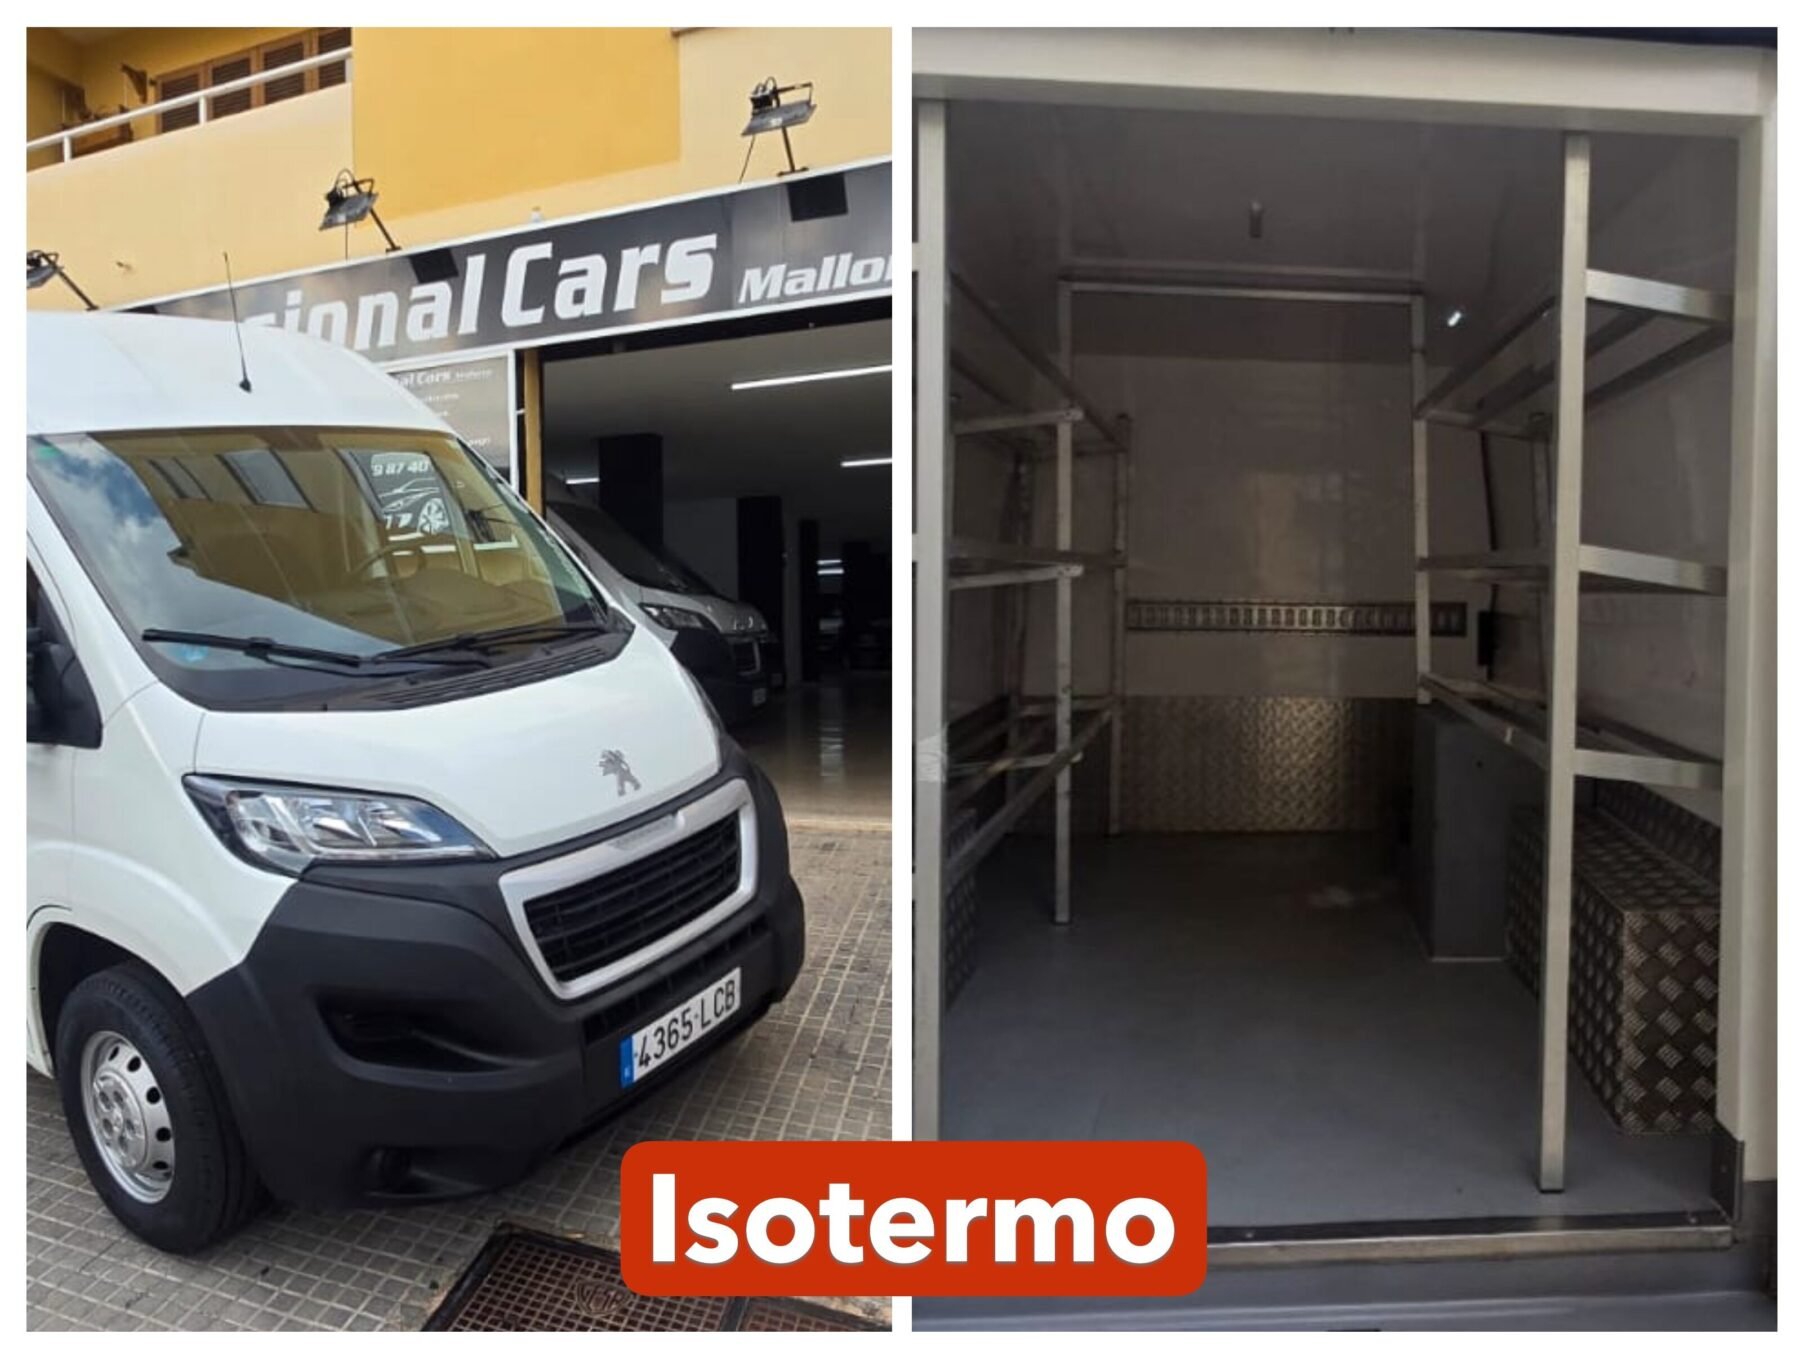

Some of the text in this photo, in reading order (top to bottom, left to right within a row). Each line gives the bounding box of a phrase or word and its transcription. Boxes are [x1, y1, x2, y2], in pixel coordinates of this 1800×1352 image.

[243, 233, 892, 350] ional Cars Mallo
[638, 979, 736, 1068] 4365 LCB
